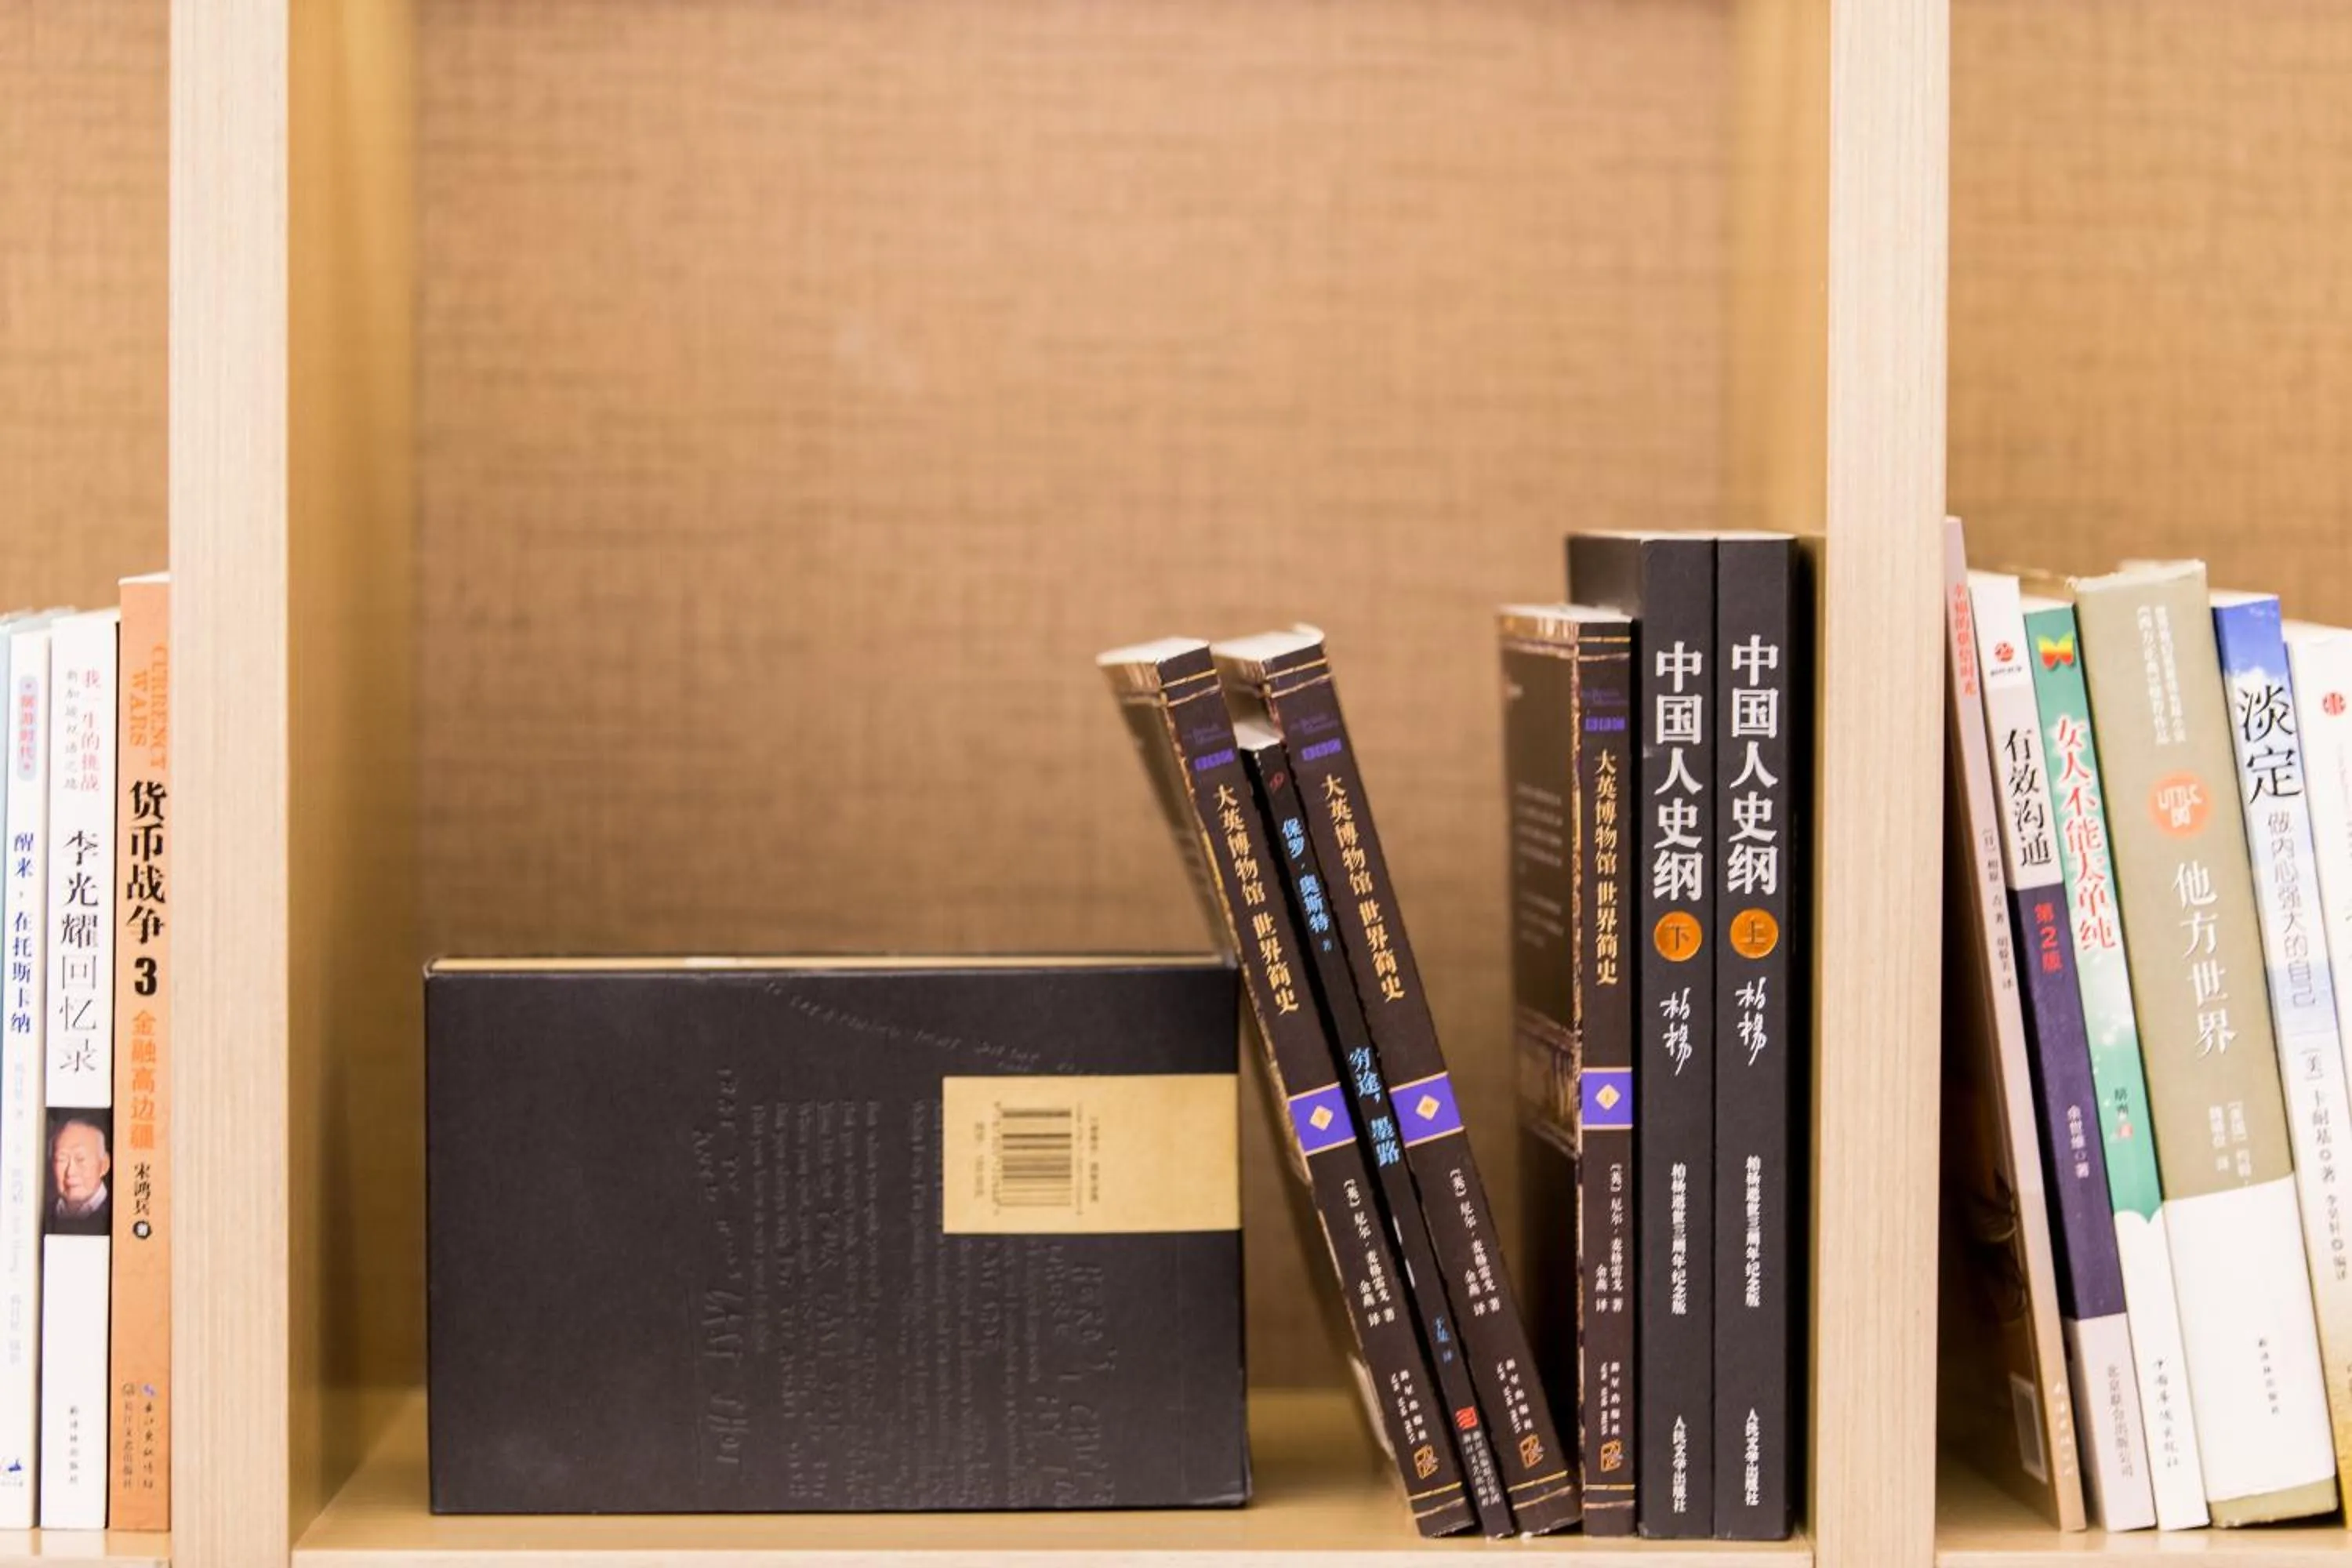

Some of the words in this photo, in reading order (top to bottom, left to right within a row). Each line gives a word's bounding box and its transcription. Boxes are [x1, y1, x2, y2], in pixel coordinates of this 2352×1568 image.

[1653, 641, 1702, 901] 中国人史纲
[1728, 634, 1778, 895] 中国人史纲
[2005, 728, 2052, 868] 有效沟通
[2238, 684, 2303, 805] 淡定
[2056, 713, 2118, 953] 女人不能太单纯
[2268, 811, 2318, 1008] 做内心强大的自己
[59, 830, 99, 1073] 李光耀回忆录
[1667, 924, 1690, 951] 下
[1743, 920, 1767, 946] 上
[2034, 904, 2062, 975] 第2版
[2173, 860, 2237, 1058] 他方世界
[130, 1010, 157, 1150] 金融高边疆
